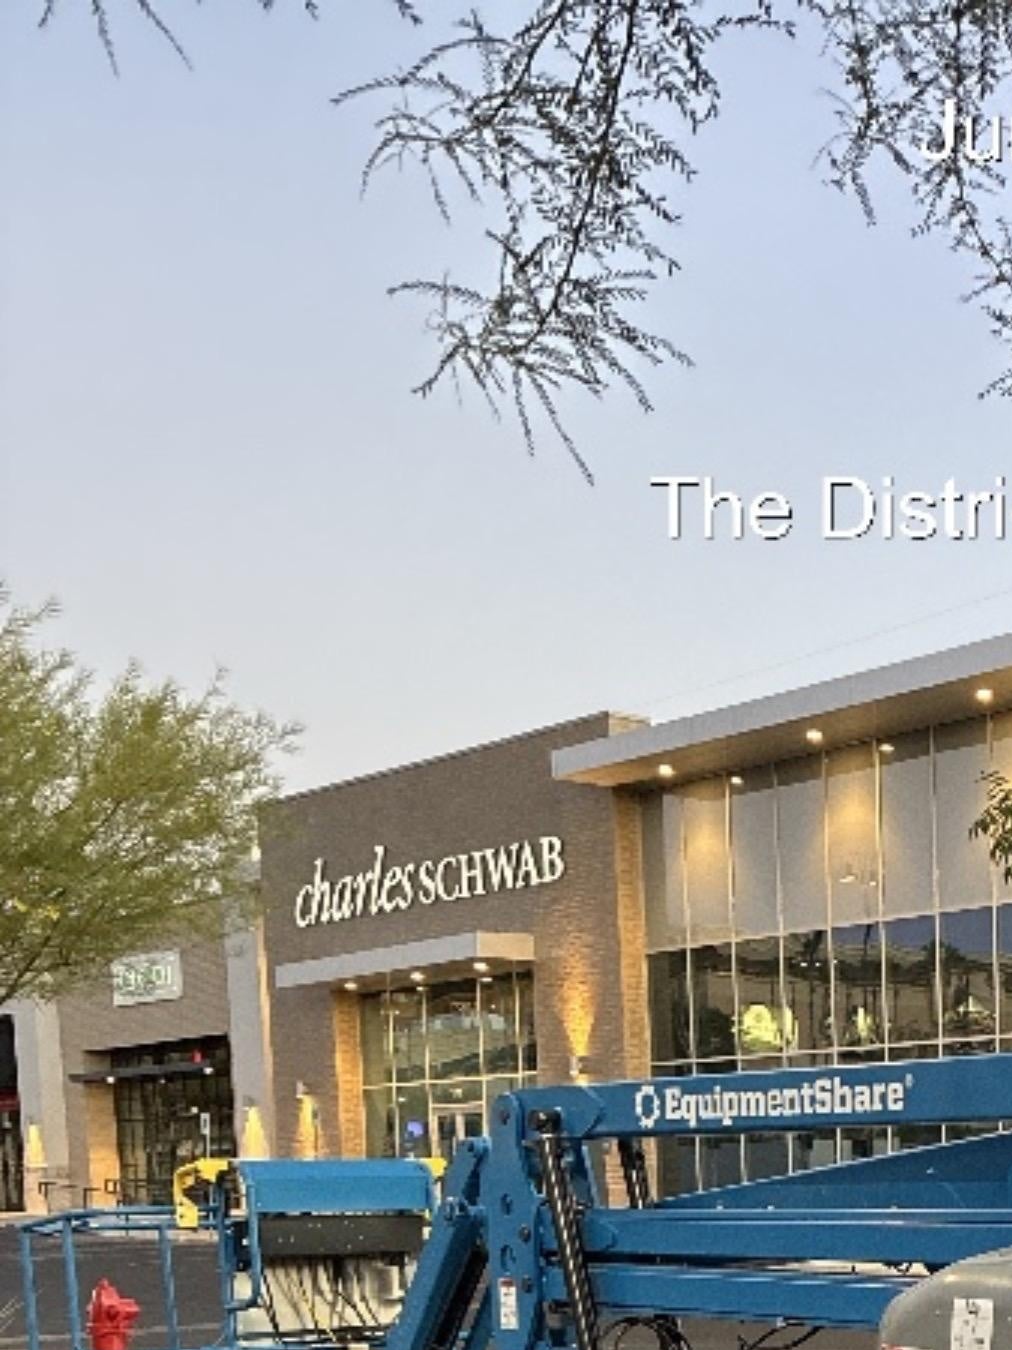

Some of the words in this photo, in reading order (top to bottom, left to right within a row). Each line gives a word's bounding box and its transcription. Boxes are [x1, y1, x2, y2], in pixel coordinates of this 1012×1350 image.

[295, 844, 415, 928] charles
[418, 836, 565, 904] SCHWAB
[664, 1076, 905, 1127] EquipmentShare
